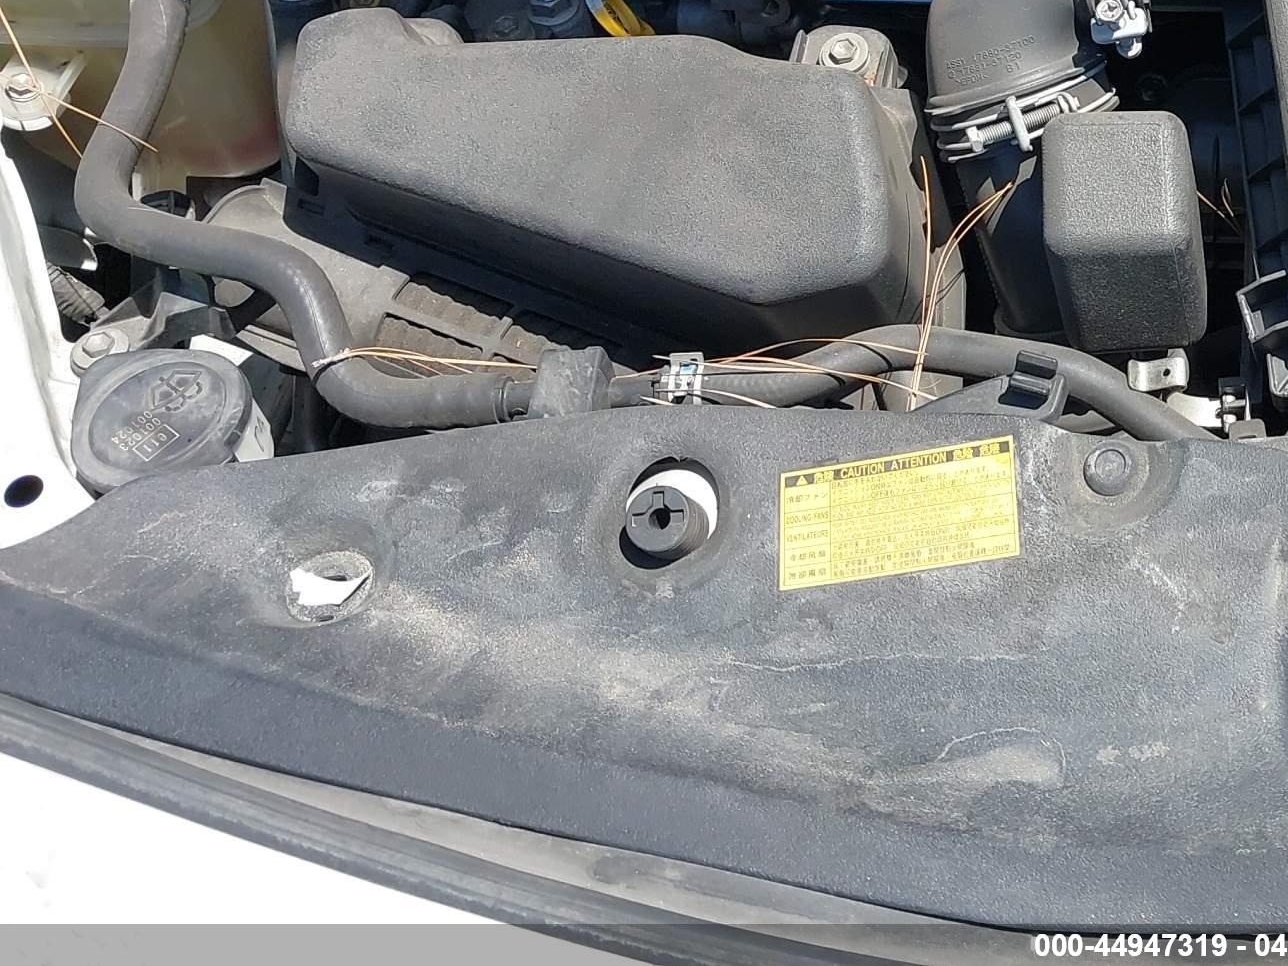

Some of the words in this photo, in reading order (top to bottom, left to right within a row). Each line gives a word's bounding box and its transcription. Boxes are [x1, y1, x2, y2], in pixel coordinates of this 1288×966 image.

[840, 462, 885, 479] CAUTION
[890, 452, 947, 471] ATTENTION
[786, 514, 812, 525] COOLING
